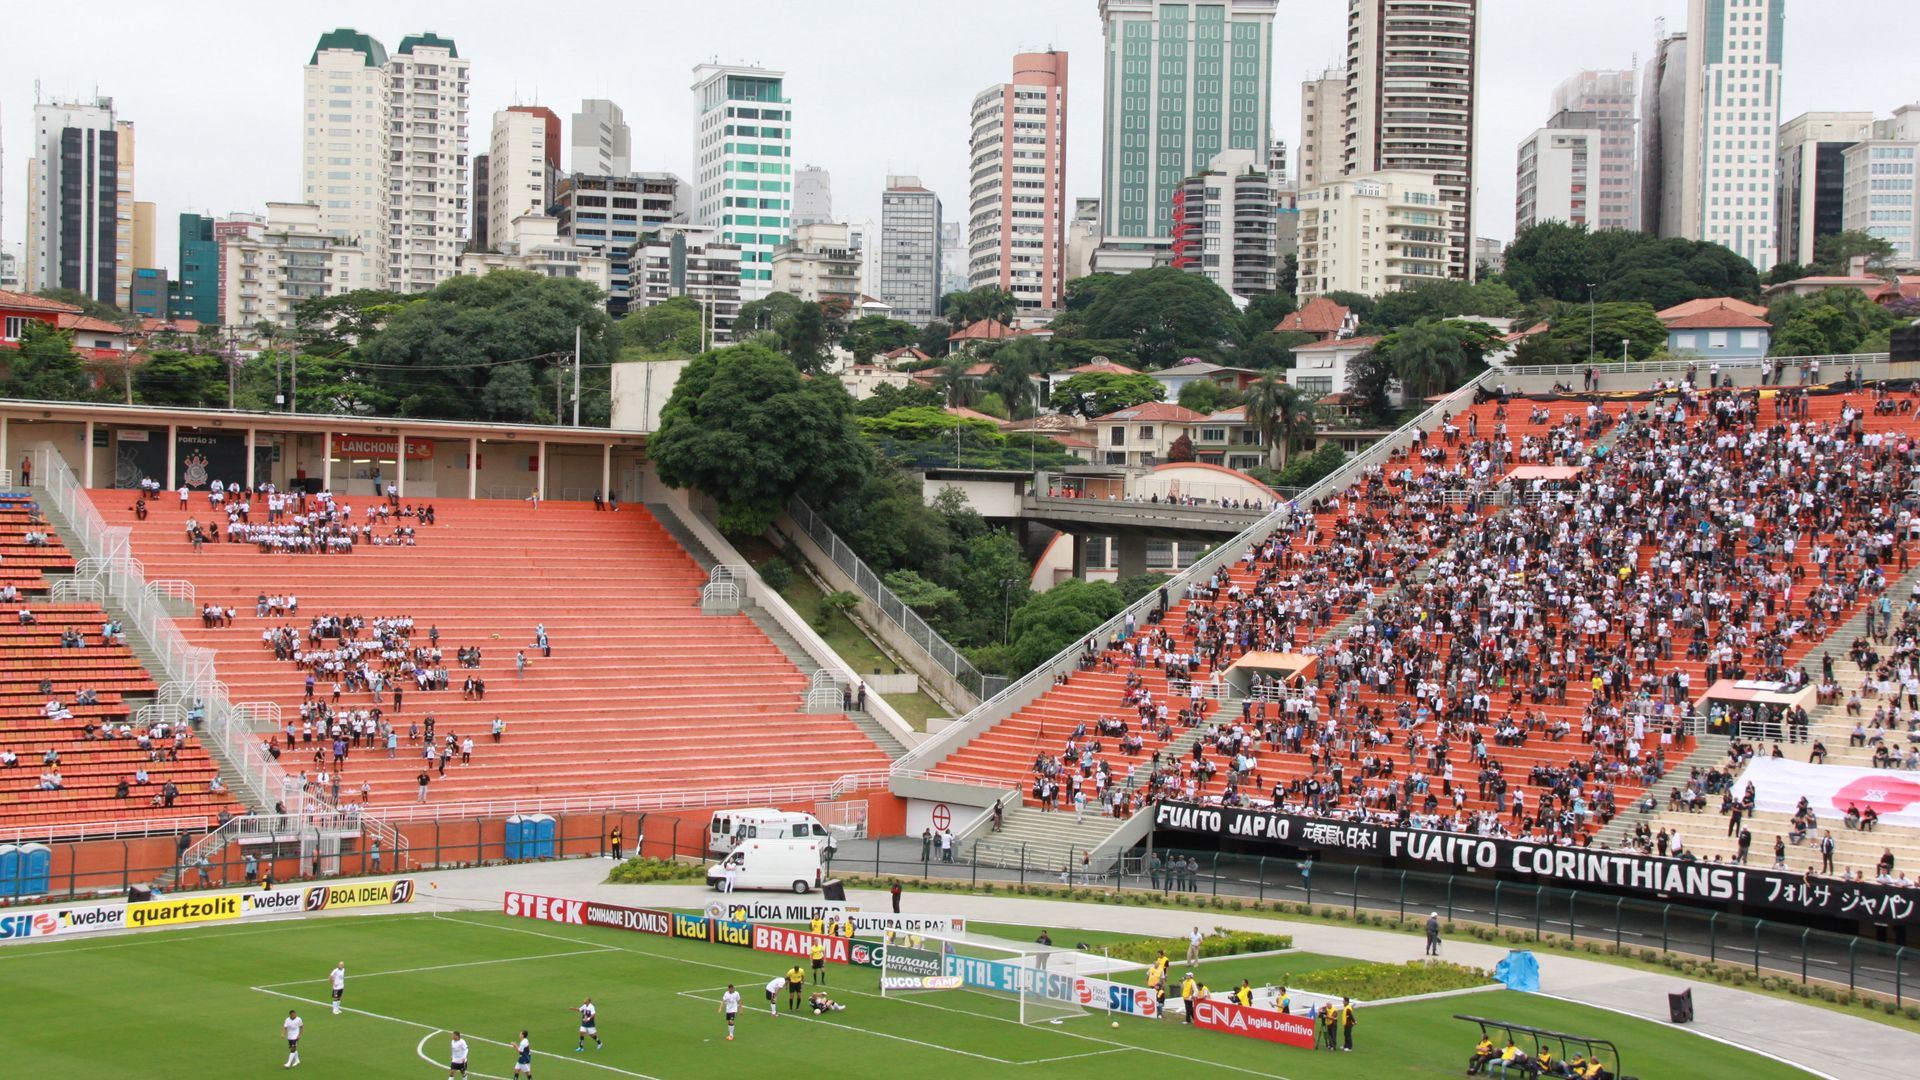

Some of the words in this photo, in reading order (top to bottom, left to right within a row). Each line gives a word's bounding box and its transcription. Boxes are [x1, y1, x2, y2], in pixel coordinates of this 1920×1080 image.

[178, 436, 207, 444] PORTÃO
[341, 441, 414, 454] LANCHONEE
[1157, 805, 1221, 832] FUAITO
[1229, 814, 1290, 840] JAPÃO
[1389, 831, 1497, 868] FUAITO
[1512, 846, 1746, 901] CORINTHIANS!
[254, 892, 300, 909] weber
[307, 888, 325, 910] 51
[330, 889, 355, 904] BOA
[358, 887, 388, 902] IDEIA
[391, 880, 409, 903] 51
[1765, 877, 1831, 907] フォルサ
[1841, 889, 1914, 919] ジャパン
[72, 908, 124, 925] weber
[133, 898, 235, 926] quartzolit
[506, 893, 584, 925] STECK
[587, 905, 624, 925] CONHAQUE
[624, 910, 668, 934] DOMUS
[728, 901, 782, 920] PLÍCIA
[0, 915, 33, 939] Sil
[676, 915, 707, 938] Itaú
[718, 921, 749, 945] Itaú
[881, 977, 922, 988] SUCOS
[927, 977, 960, 986] CAMP
[1048, 974, 1073, 1001] Sil
[1109, 986, 1134, 1013] Sil
[1195, 1002, 1248, 1030] CNA
[1248, 1015, 1272, 1030] Inglês
[1274, 1019, 1313, 1037] Definitivo
